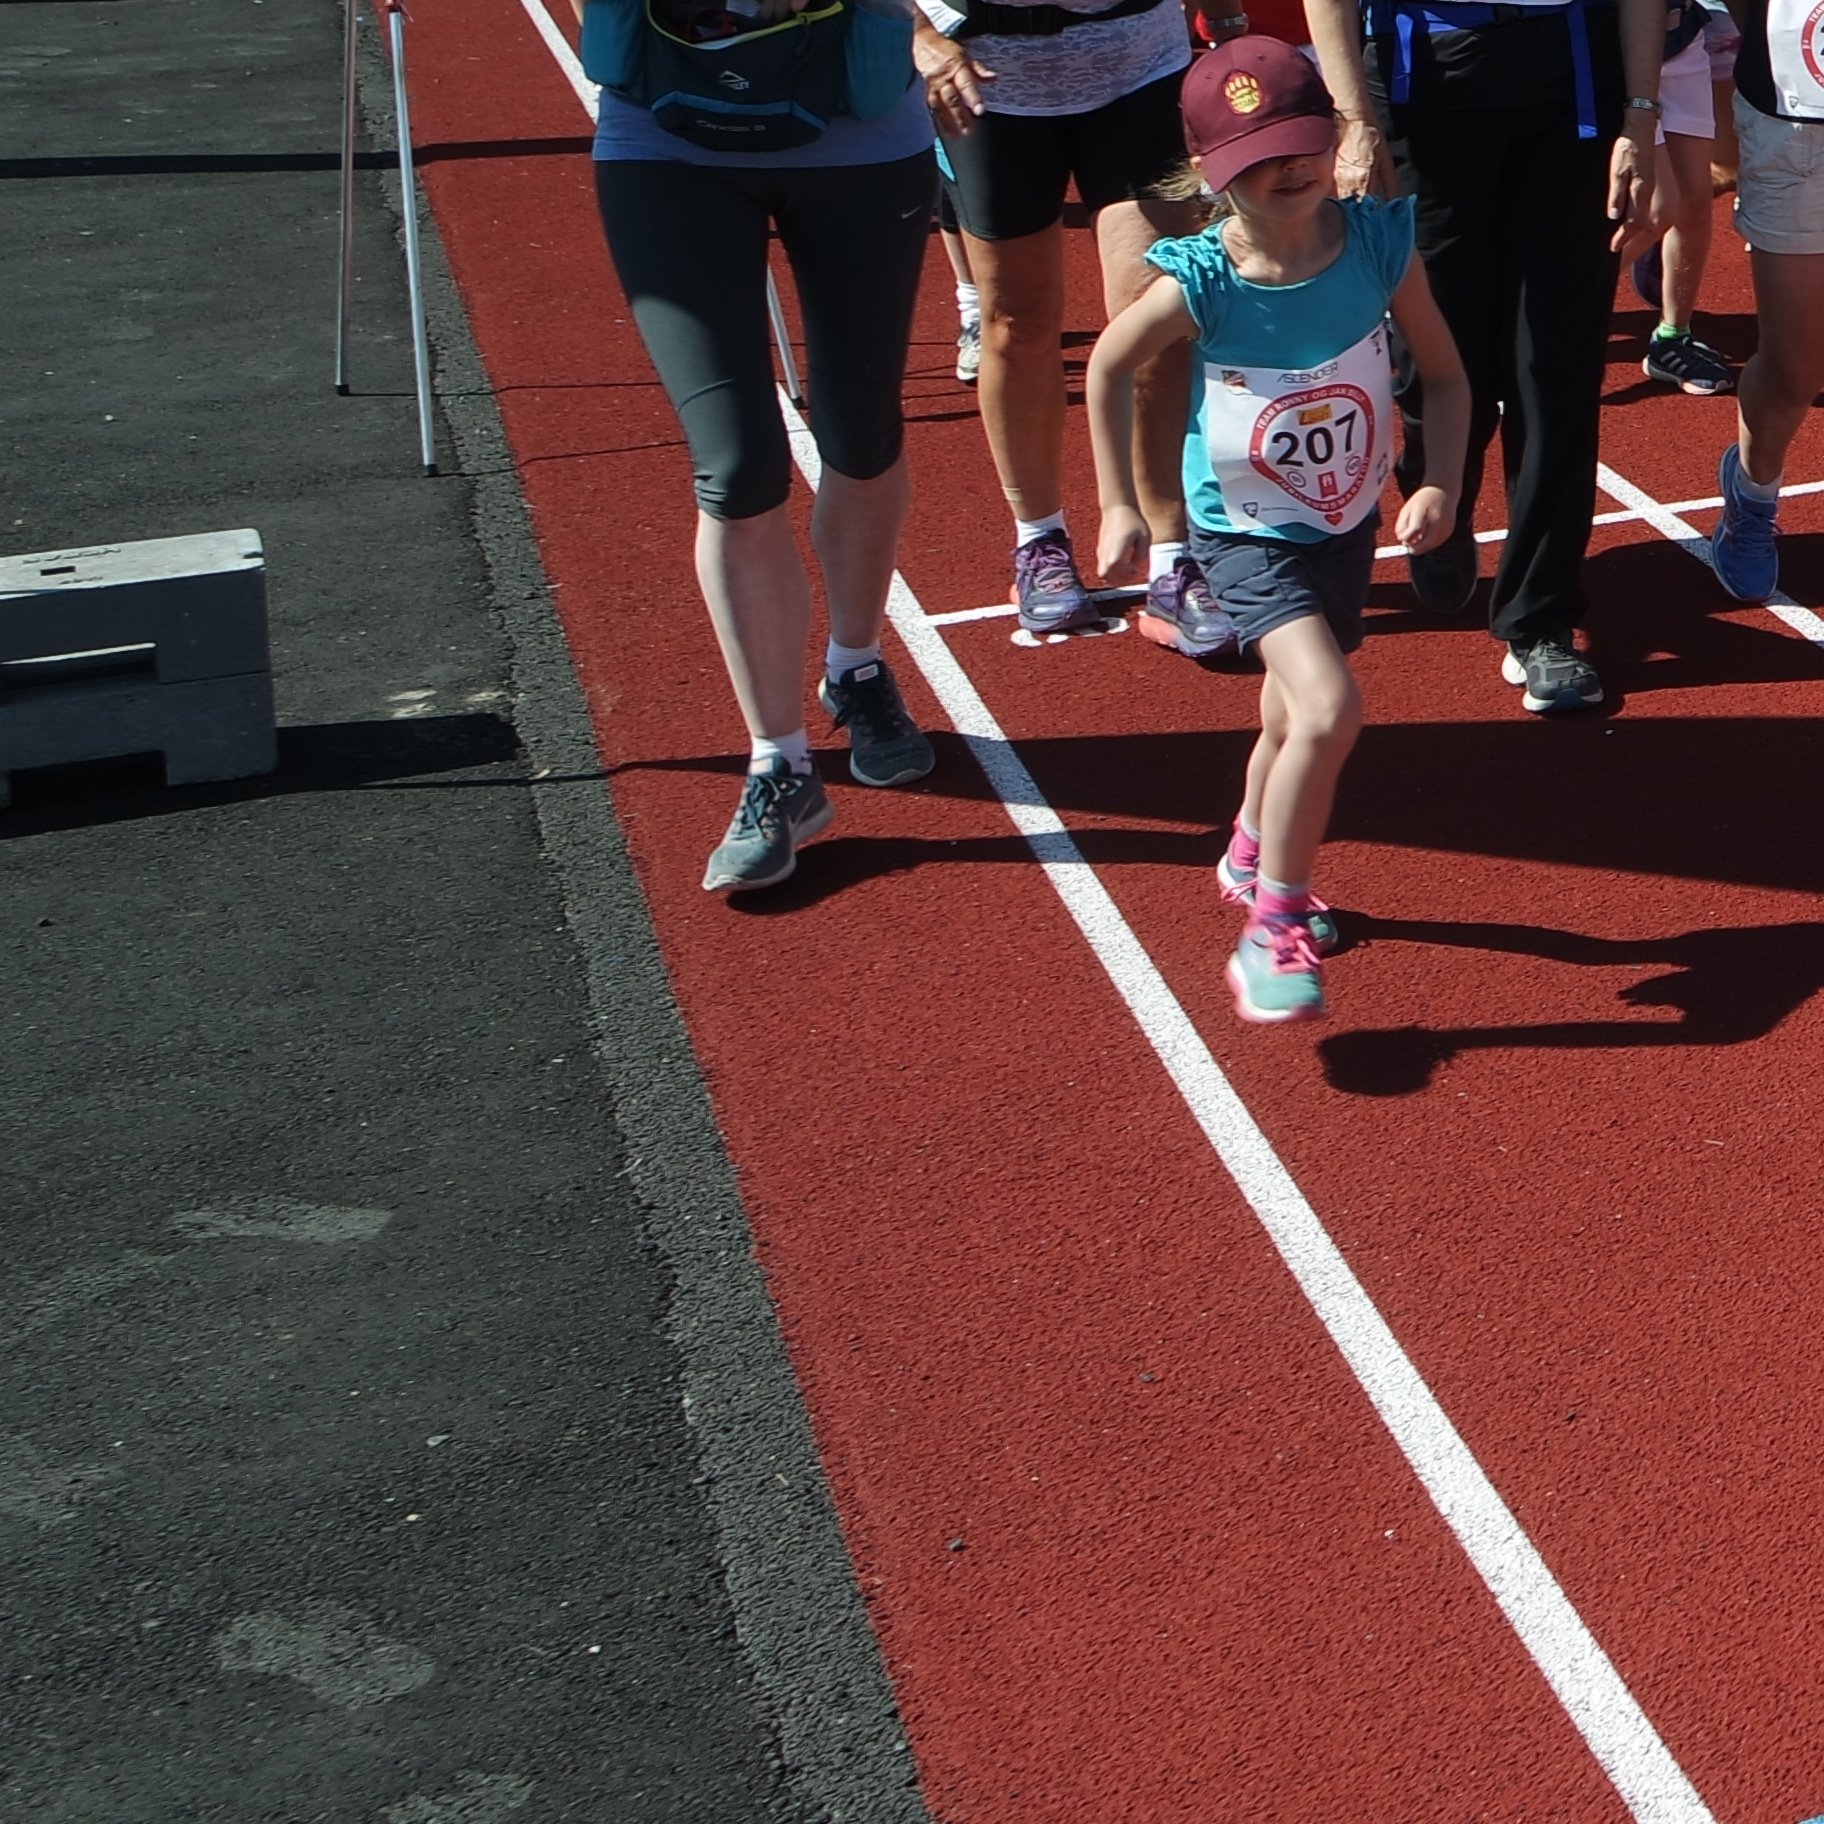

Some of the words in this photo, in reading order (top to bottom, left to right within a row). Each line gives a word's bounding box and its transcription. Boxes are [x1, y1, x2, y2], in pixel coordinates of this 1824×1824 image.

[1277, 361, 1339, 384] ASCENDER
[1256, 407, 1275, 430] TEAM
[1311, 390, 1328, 400] OG
[1271, 409, 1358, 467] 207
